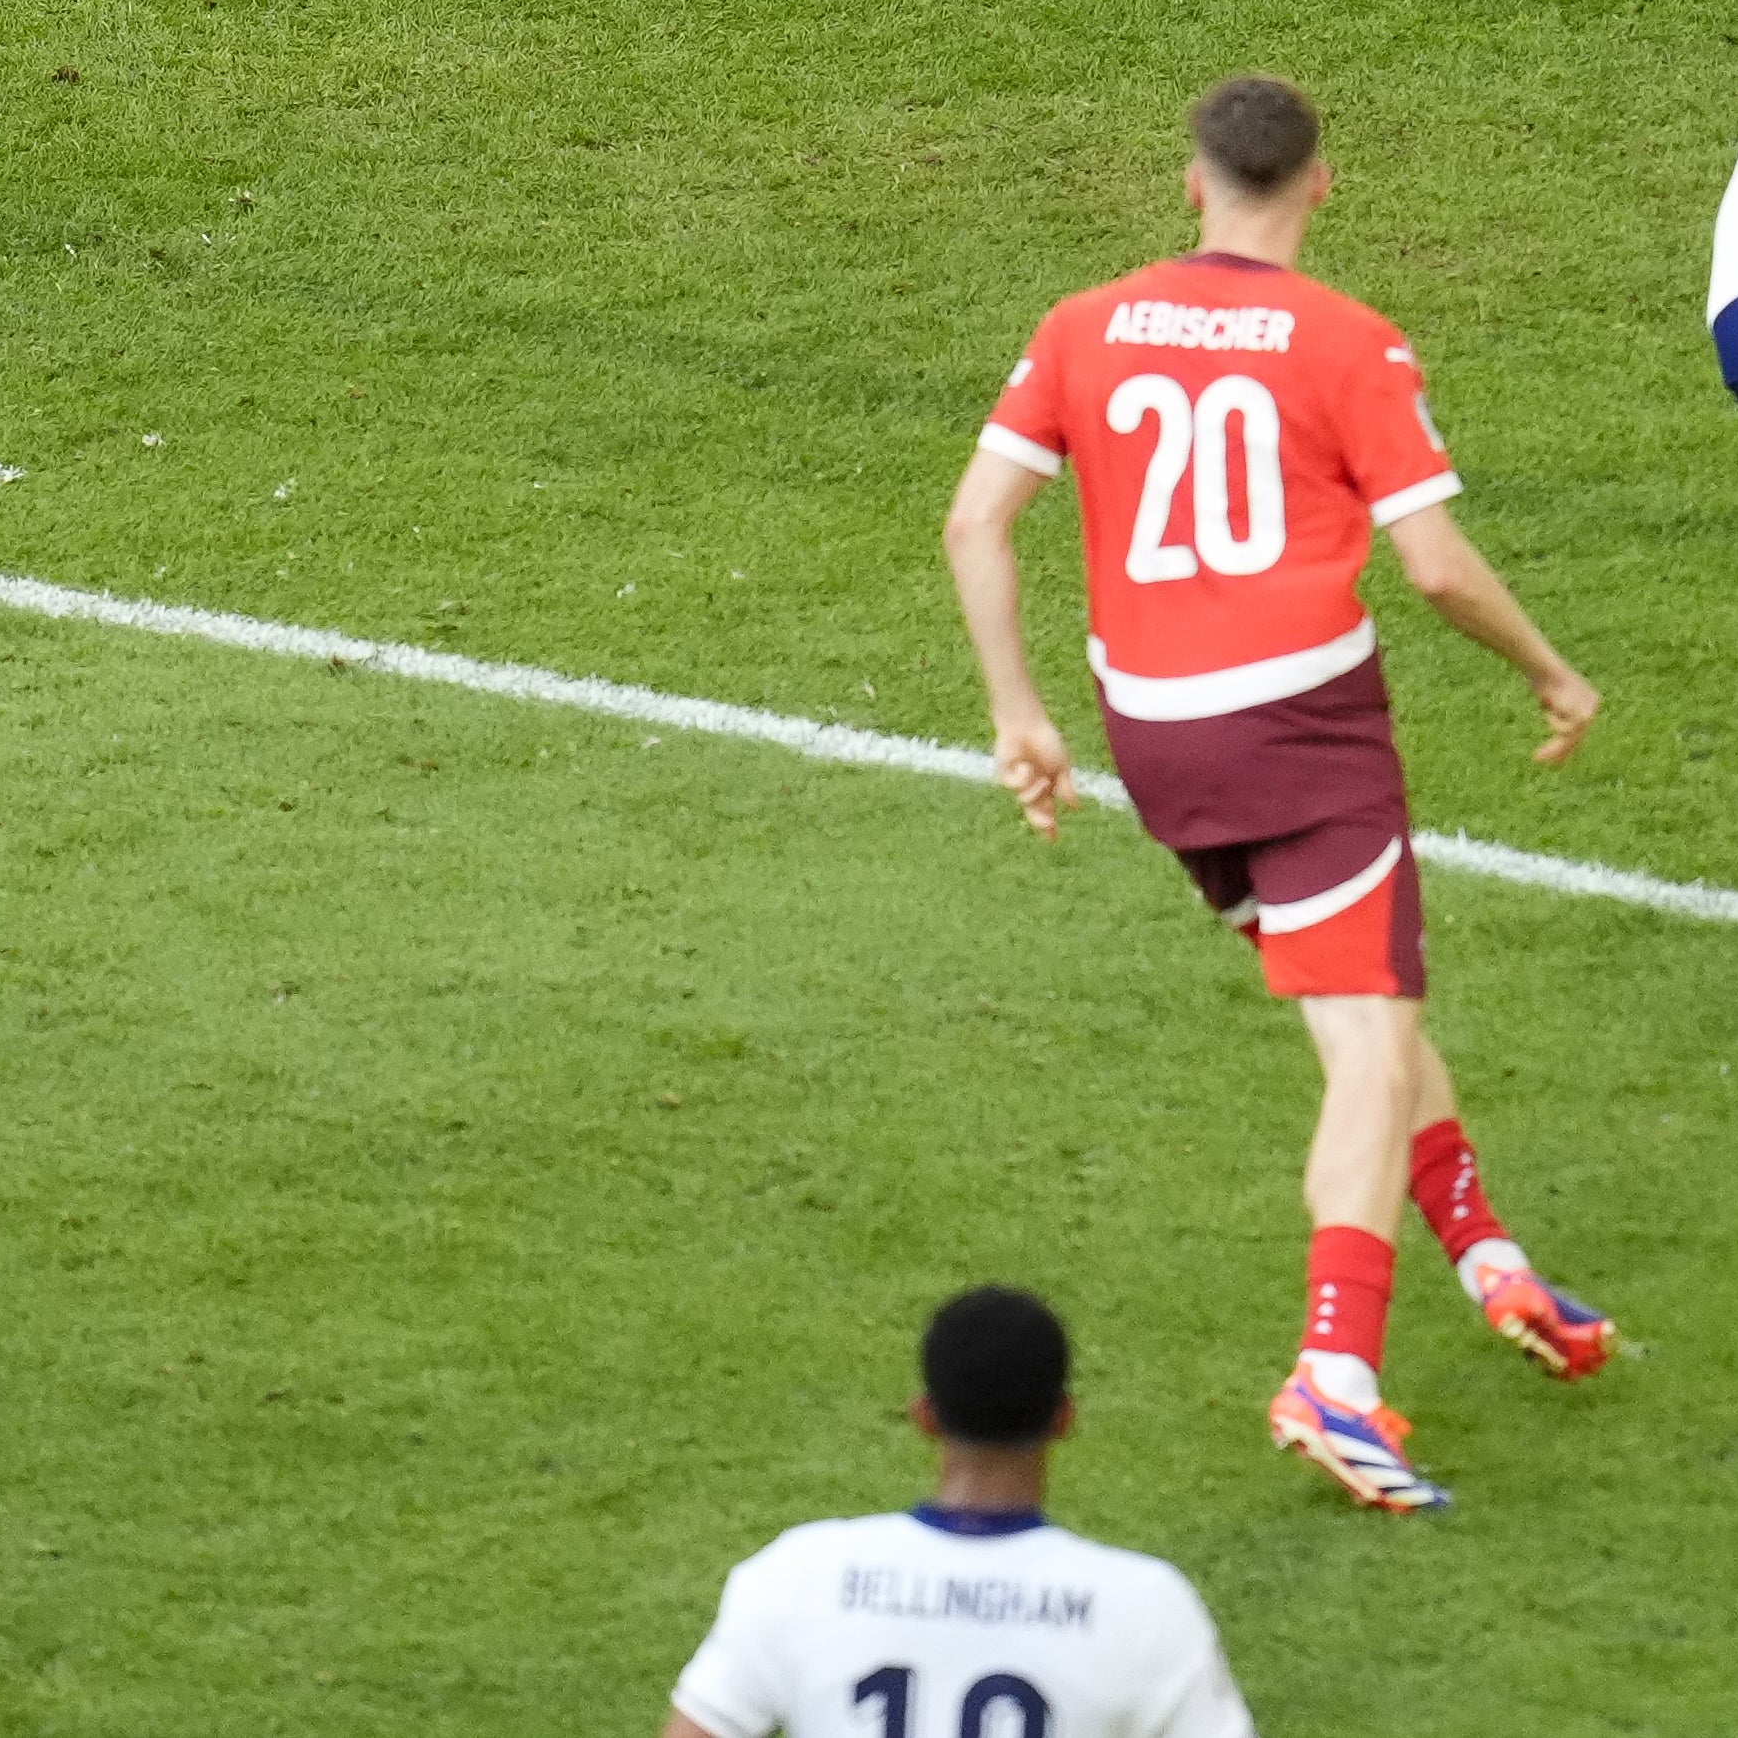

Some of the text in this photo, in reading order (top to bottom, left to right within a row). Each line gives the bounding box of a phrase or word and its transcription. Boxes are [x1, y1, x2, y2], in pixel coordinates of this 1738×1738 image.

[1104, 300, 1296, 353] AEBISCHER
[1106, 373, 1287, 584] 20
[838, 1563, 1096, 1630] BELLINGHAM
